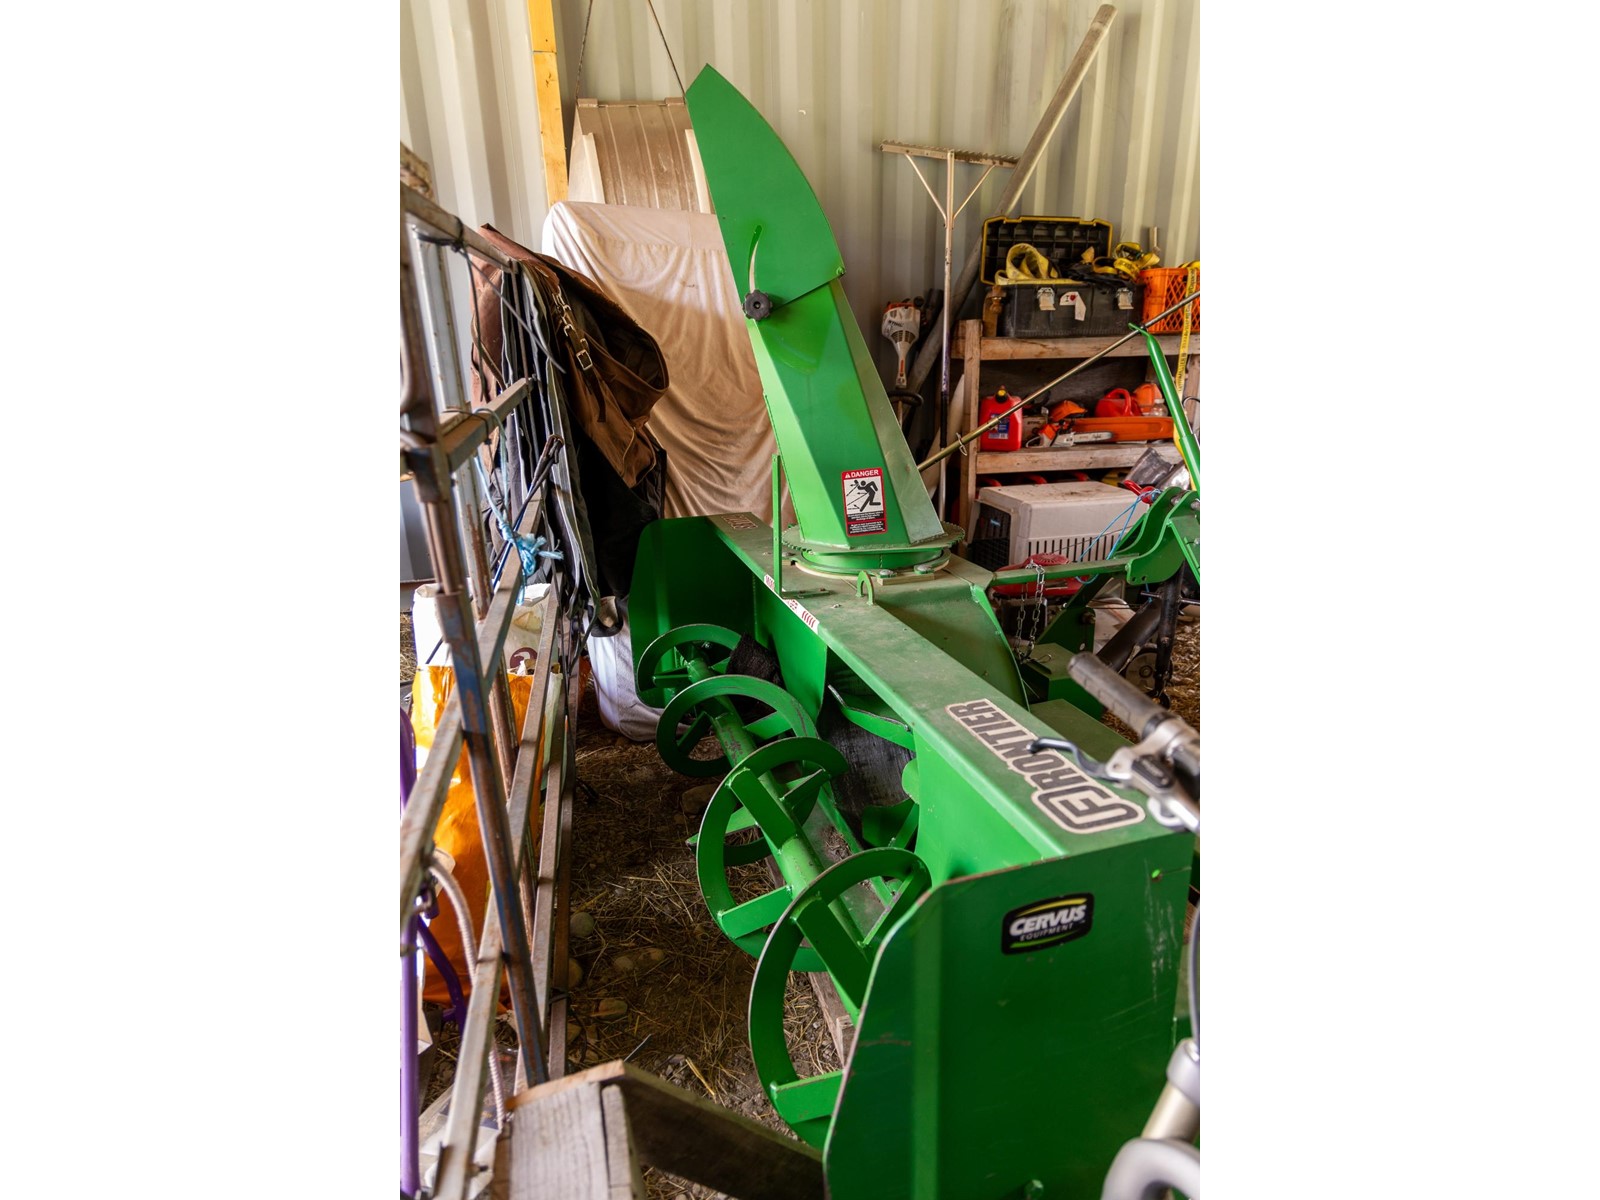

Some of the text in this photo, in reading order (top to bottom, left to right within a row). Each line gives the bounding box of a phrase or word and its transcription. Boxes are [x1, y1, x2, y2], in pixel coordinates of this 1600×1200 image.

[851, 469, 879, 478] DANGER
[948, 700, 1140, 831] FRONTIER
[1009, 904, 1087, 937] CERVUS
[1020, 922, 1074, 941] EQUIPMENT
